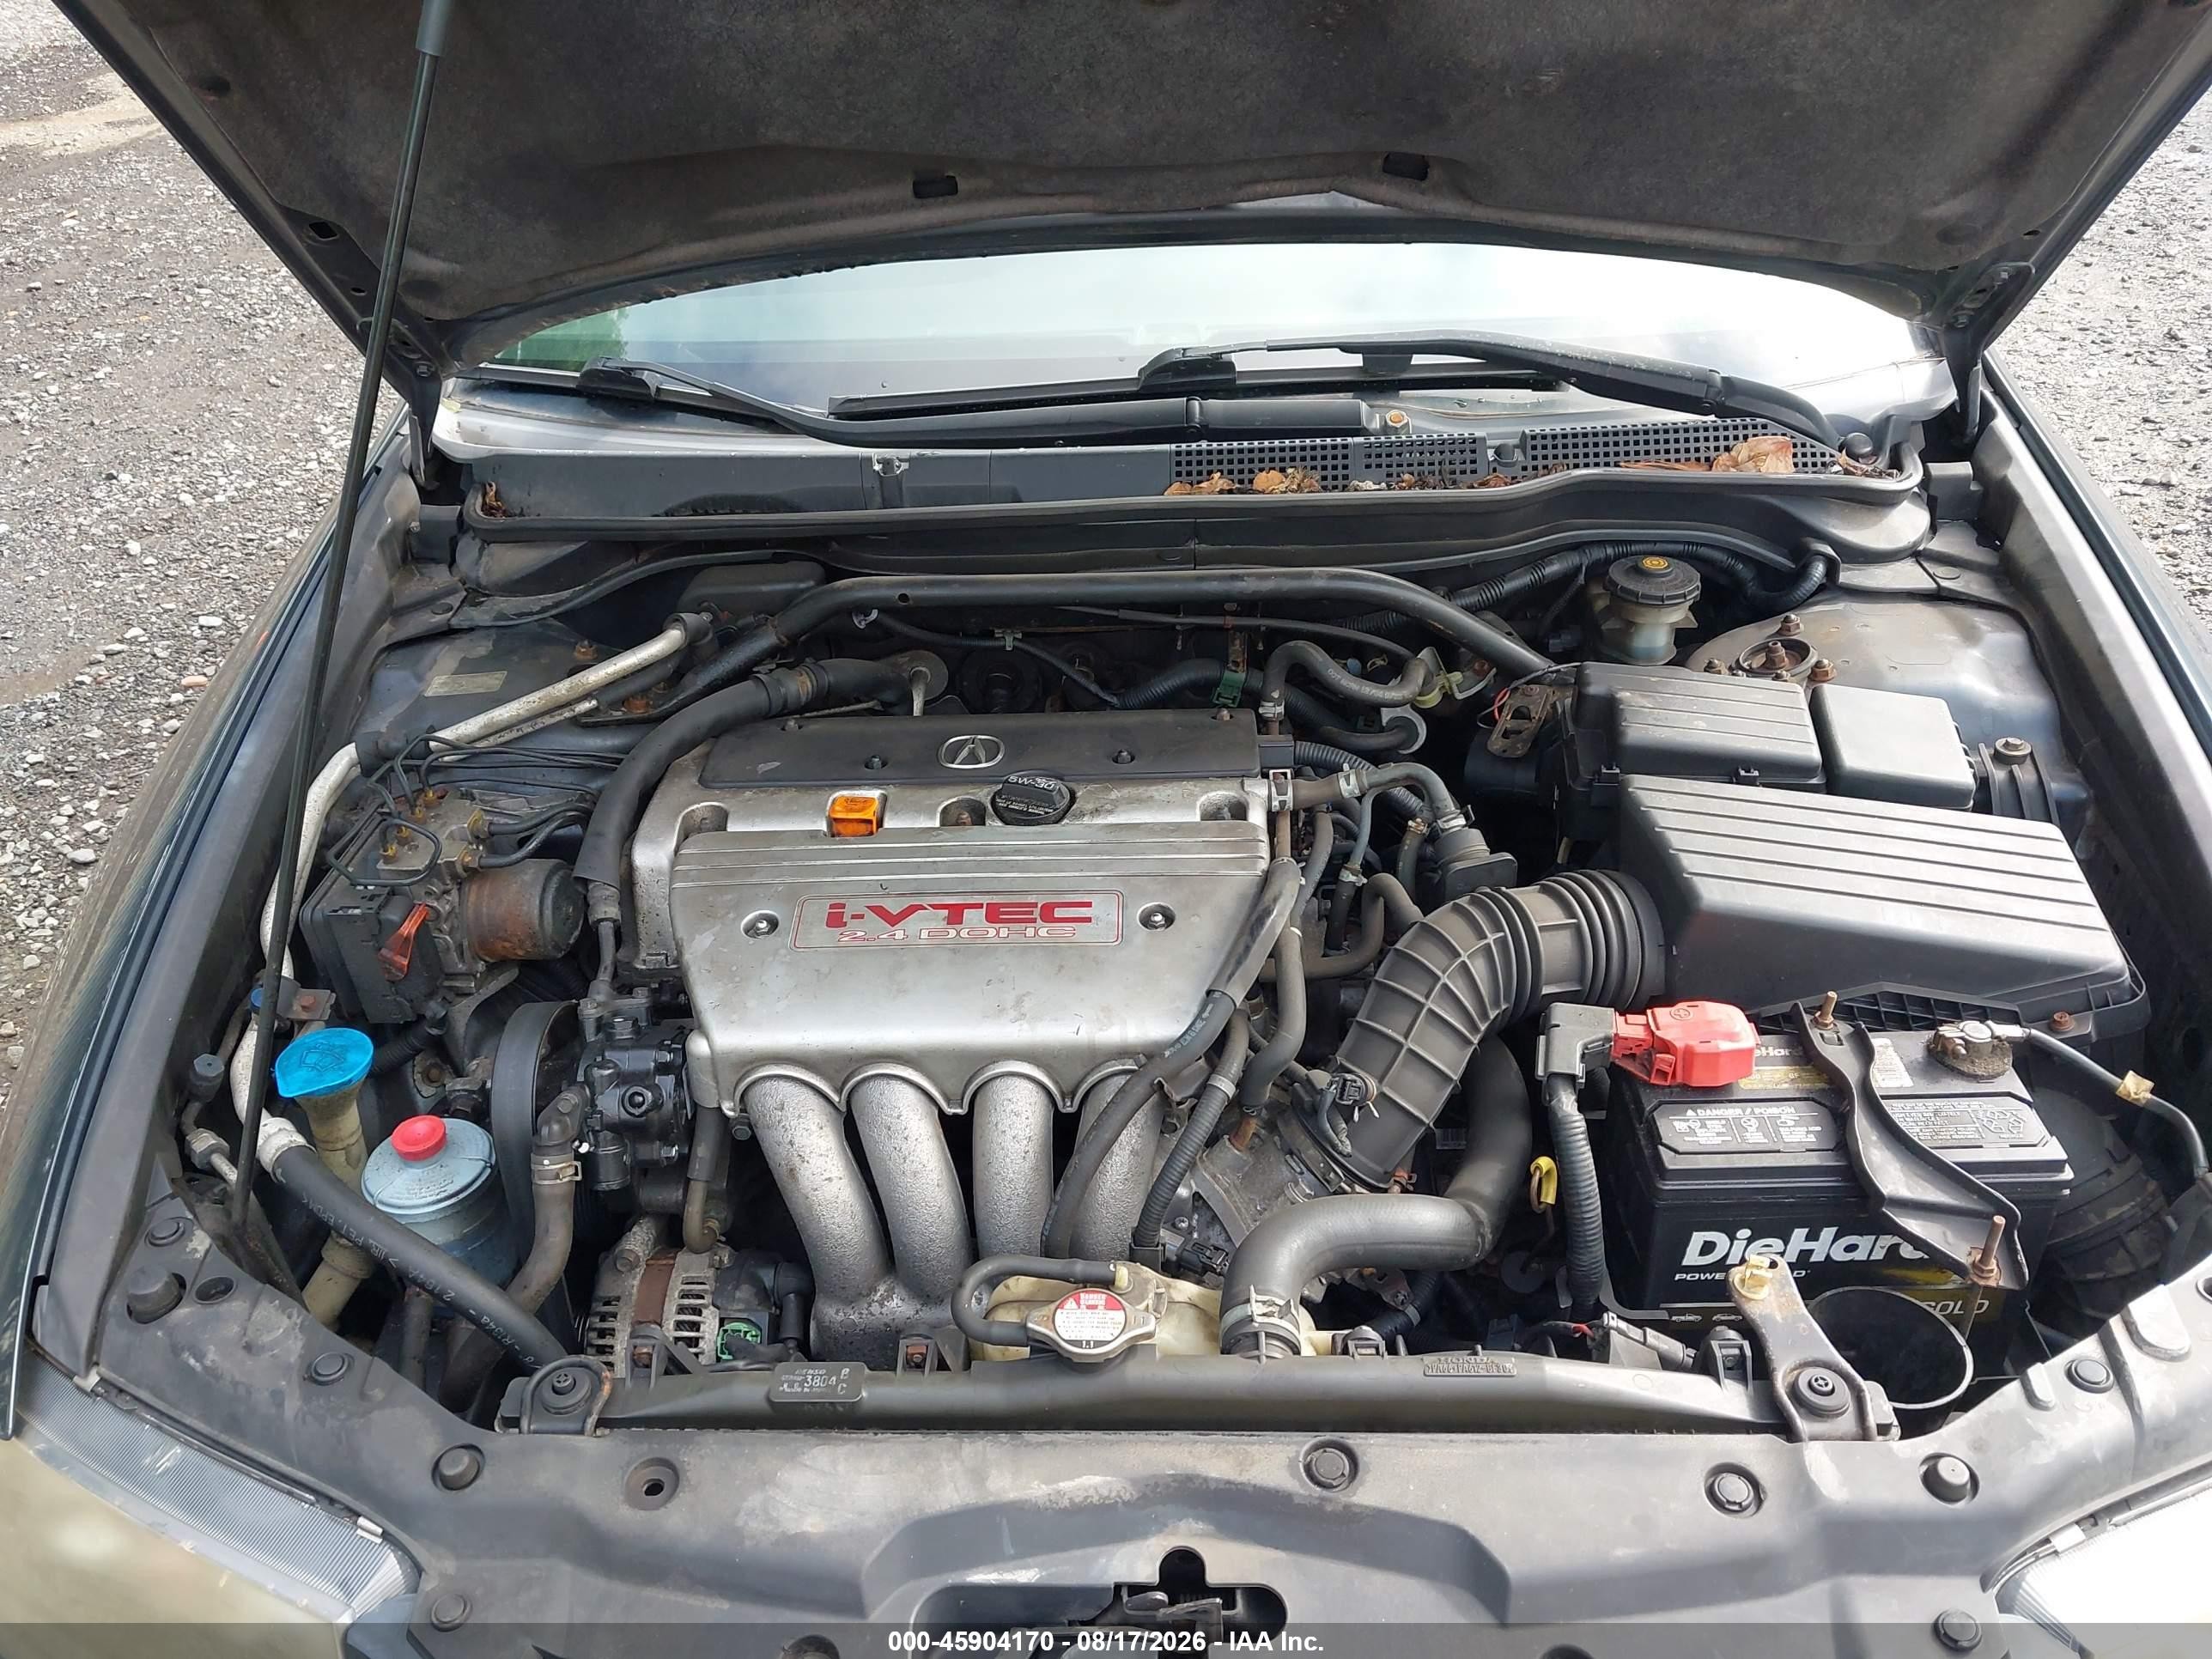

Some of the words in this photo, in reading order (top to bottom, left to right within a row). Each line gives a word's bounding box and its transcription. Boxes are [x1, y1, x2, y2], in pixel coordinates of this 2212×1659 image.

[1007, 775, 1055, 789] 5W-30
[825, 901, 1093, 929] i-VTEC
[837, 928, 908, 943] 2.4
[918, 925, 1077, 941] DOHC
[1696, 1108, 1744, 1116] DANGER
[1753, 1106, 1796, 1115] POISON
